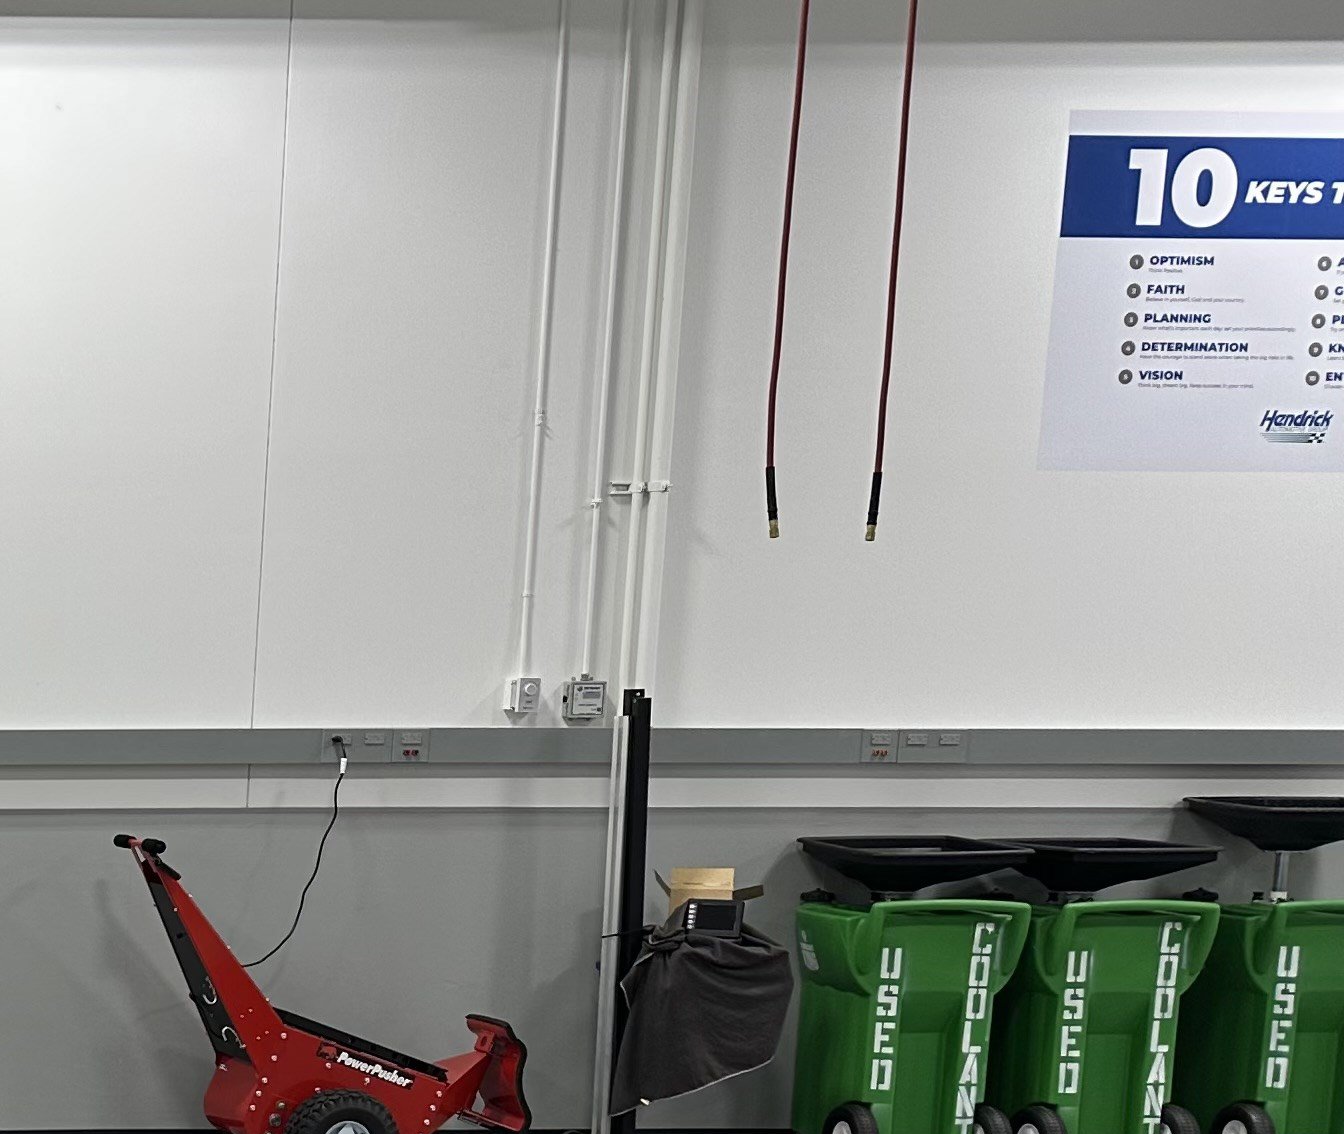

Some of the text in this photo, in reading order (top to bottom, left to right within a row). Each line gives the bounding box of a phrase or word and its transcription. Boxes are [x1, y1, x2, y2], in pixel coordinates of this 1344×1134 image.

[1128, 147, 1238, 228] 10
[1244, 180, 1325, 205] KEYS
[1149, 255, 1215, 266] OPTIMISM
[1146, 284, 1185, 295] FAITH
[1143, 313, 1212, 324] PLANNING
[1141, 341, 1249, 353] DETERMINATION
[1139, 370, 1184, 381] VISION
[1325, 371, 1344, 382] EN
[1259, 409, 1334, 432] Hendrick
[870, 947, 903, 1090] USED
[1057, 950, 1089, 1094] USED
[1265, 945, 1301, 1089] USED
[336, 1051, 412, 1087] PowerPusher
